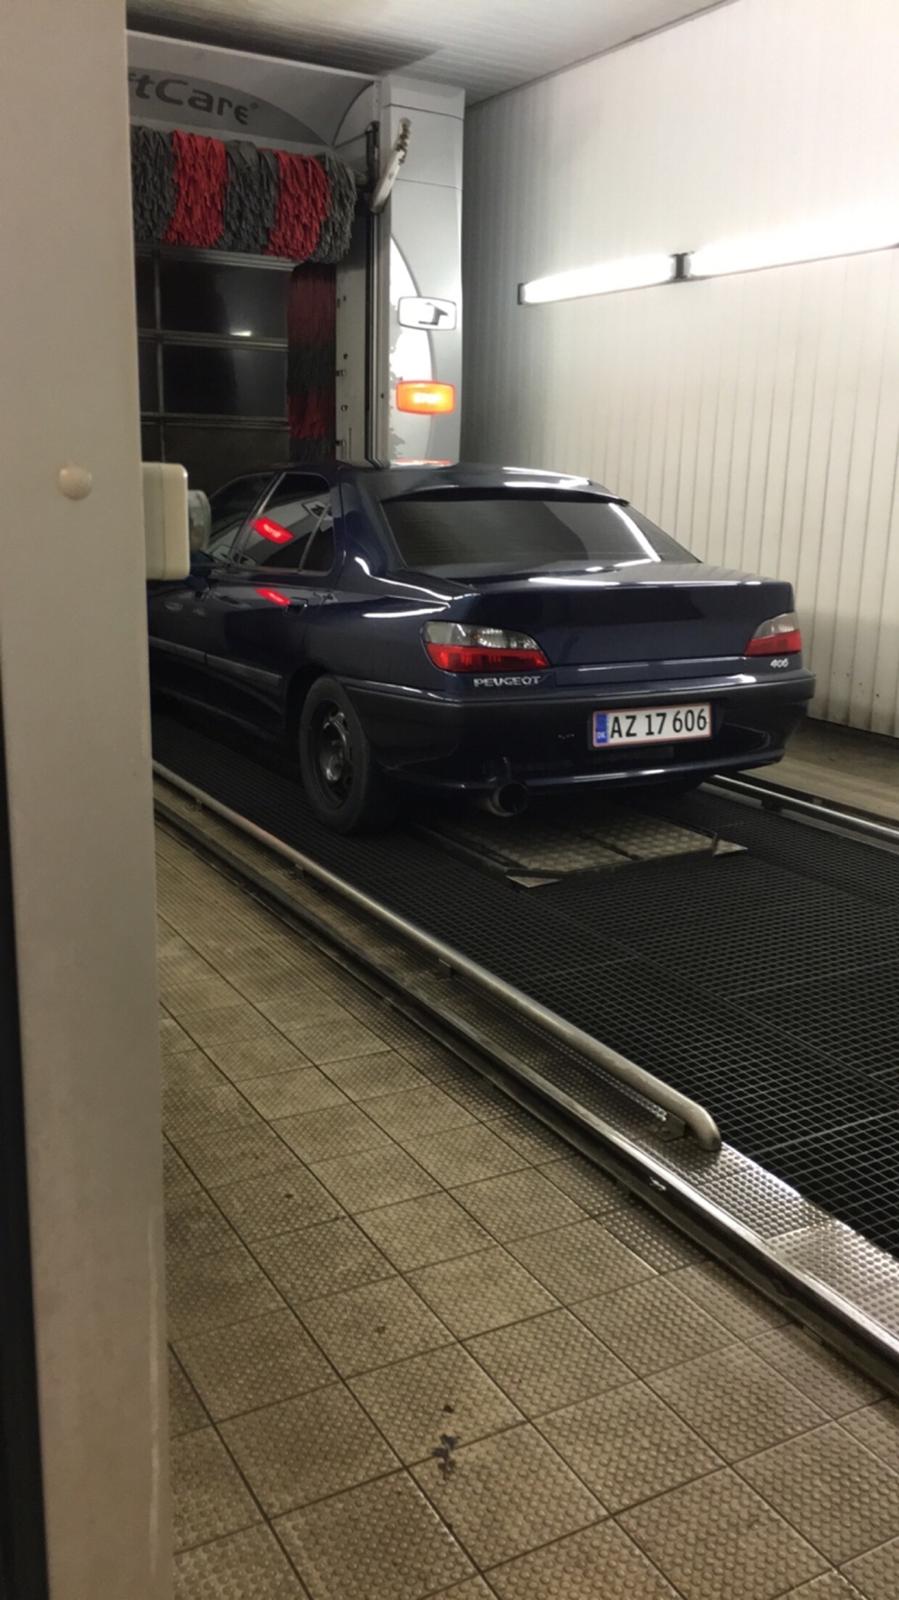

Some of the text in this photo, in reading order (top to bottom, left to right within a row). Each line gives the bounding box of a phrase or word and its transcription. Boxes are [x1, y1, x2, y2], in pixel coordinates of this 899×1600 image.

[770, 657, 789, 669] 406
[473, 675, 541, 688] PEUGEOT
[610, 708, 707, 739] AZ 17 606
